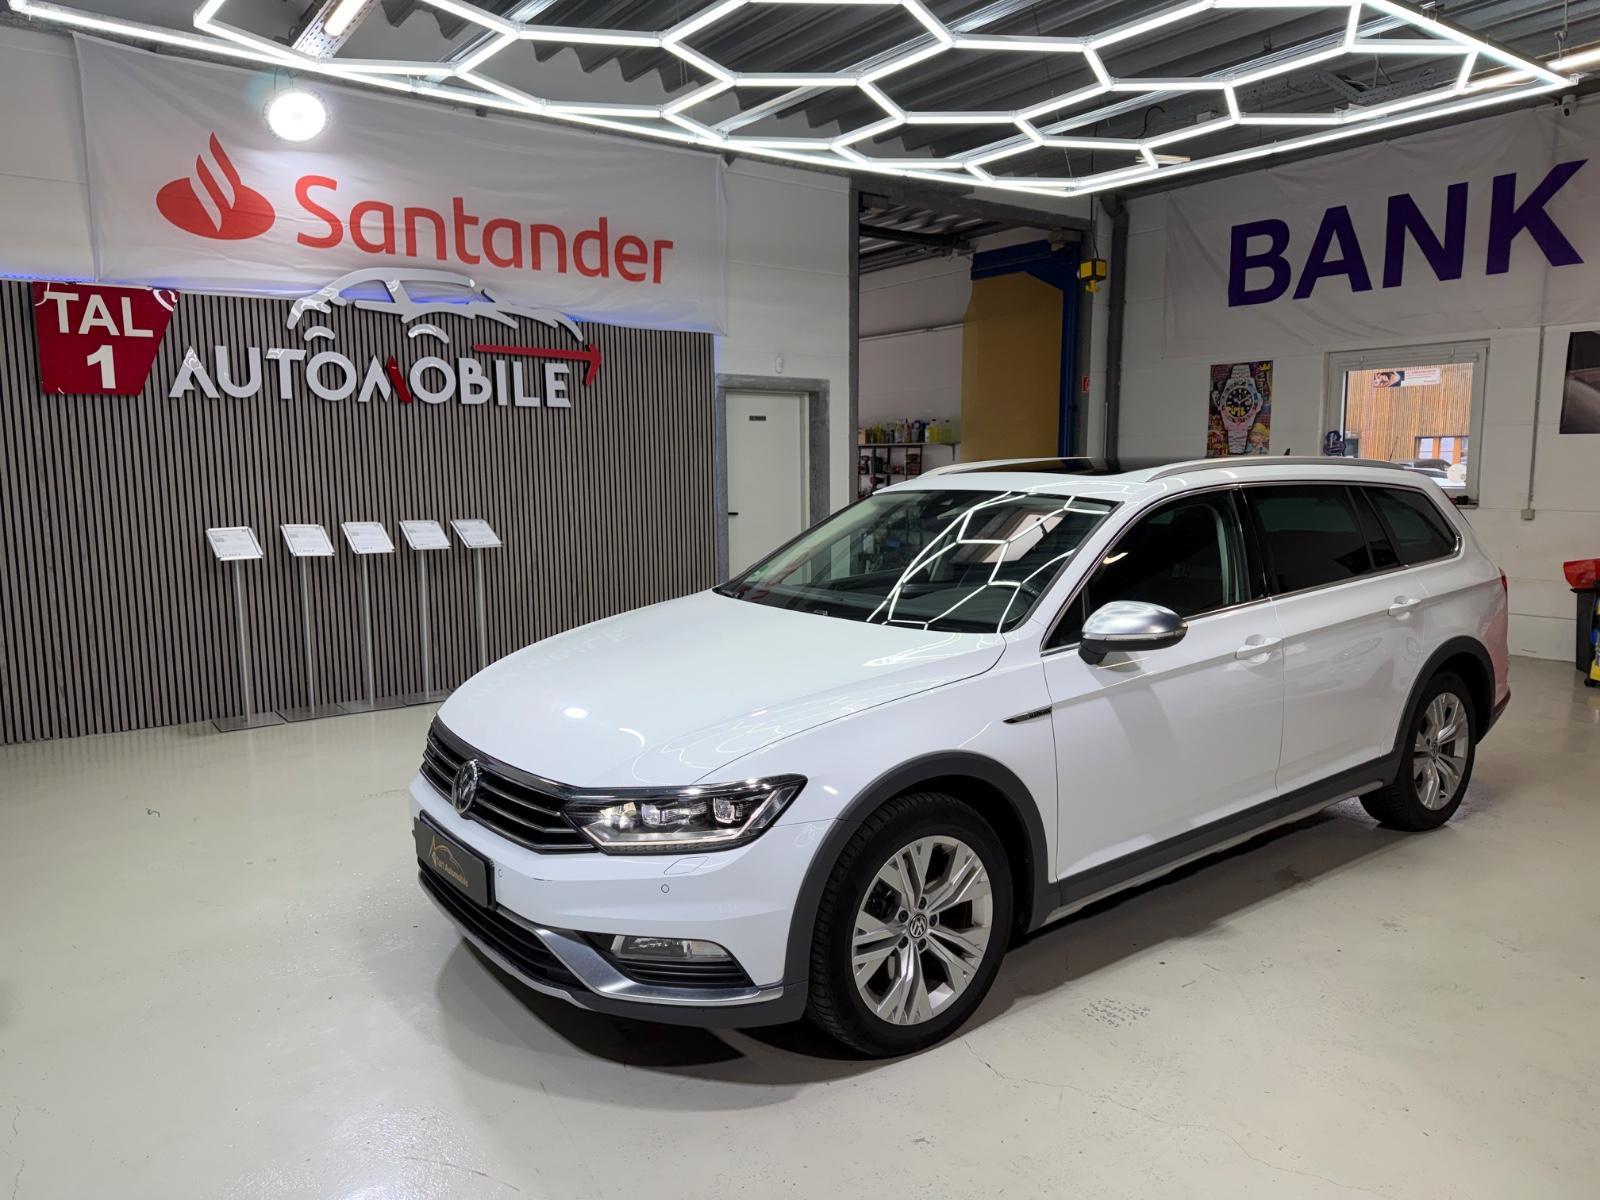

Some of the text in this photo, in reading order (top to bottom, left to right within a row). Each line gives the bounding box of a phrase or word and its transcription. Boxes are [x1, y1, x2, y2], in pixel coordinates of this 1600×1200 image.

[294, 174, 674, 285] Santander
[1228, 159, 1589, 307] BANK
[43, 290, 154, 338] TAL
[86, 344, 117, 390] 1
[168, 344, 572, 409] AUTOMOBILE
[909, 913, 927, 938] VW
